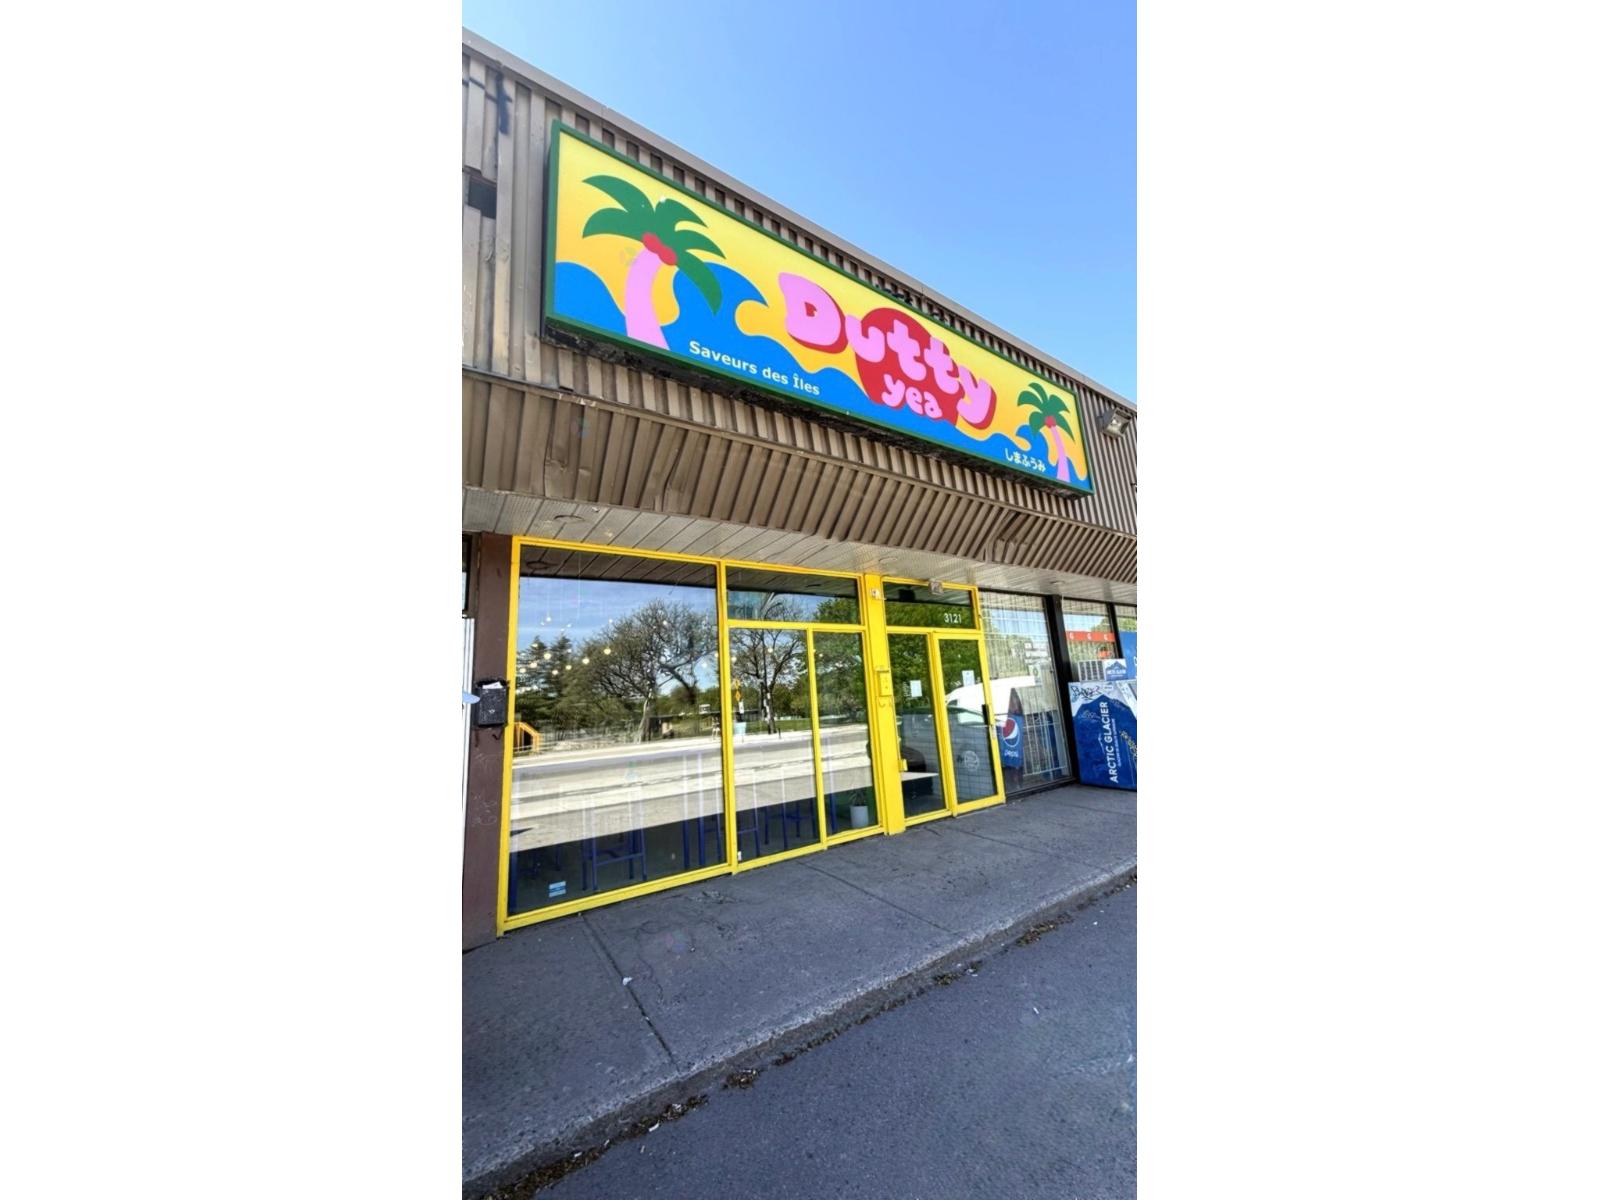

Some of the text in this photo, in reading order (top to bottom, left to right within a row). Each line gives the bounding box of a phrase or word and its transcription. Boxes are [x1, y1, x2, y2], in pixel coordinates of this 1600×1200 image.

[689, 340, 820, 396] Saveurs des Îles
[778, 272, 994, 426] Dutty
[881, 373, 943, 419] yea
[943, 612, 962, 624] 3121
[1099, 701, 1113, 743] GLACIER
[1106, 744, 1119, 783] ARCTIC
